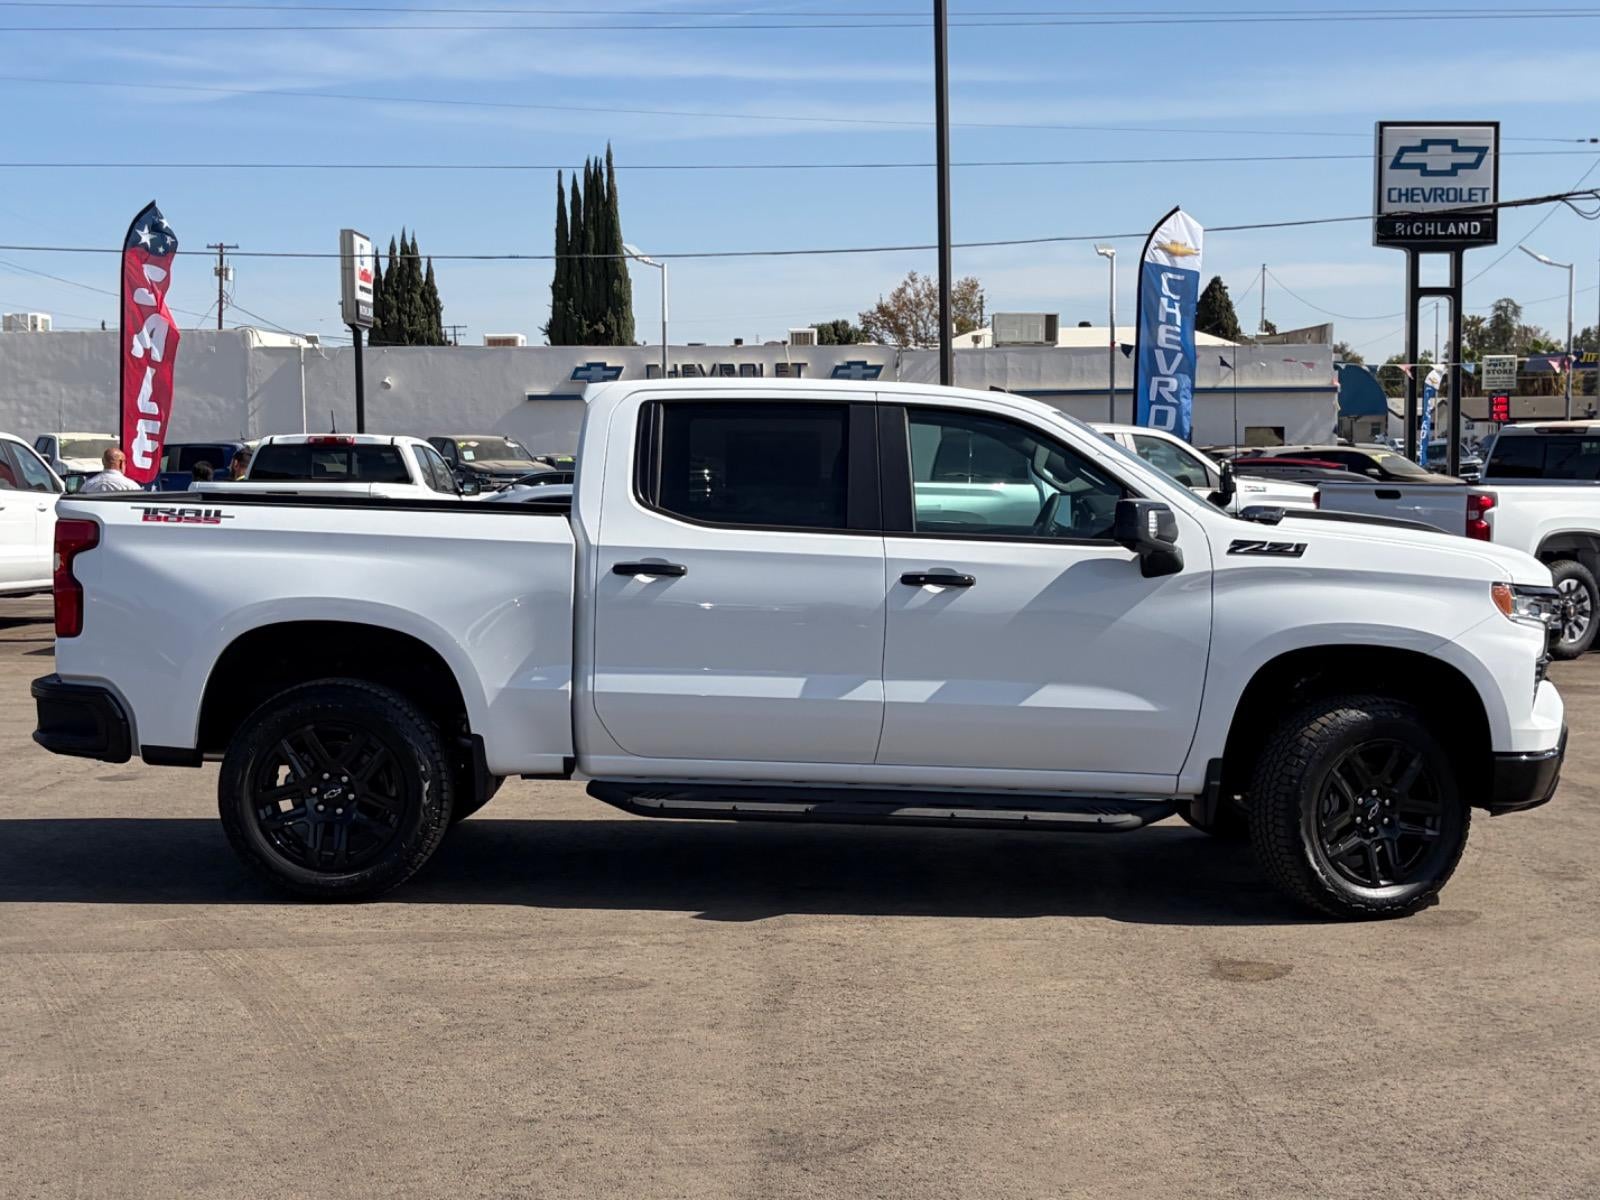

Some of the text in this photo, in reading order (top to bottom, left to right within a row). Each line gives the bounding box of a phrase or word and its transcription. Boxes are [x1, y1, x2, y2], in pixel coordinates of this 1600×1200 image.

[1387, 186, 1490, 204] CHEVROLET
[1395, 221, 1481, 236] RICHLAND
[1148, 271, 1185, 431] CHEVRO
[1226, 539, 1309, 559] Z71
